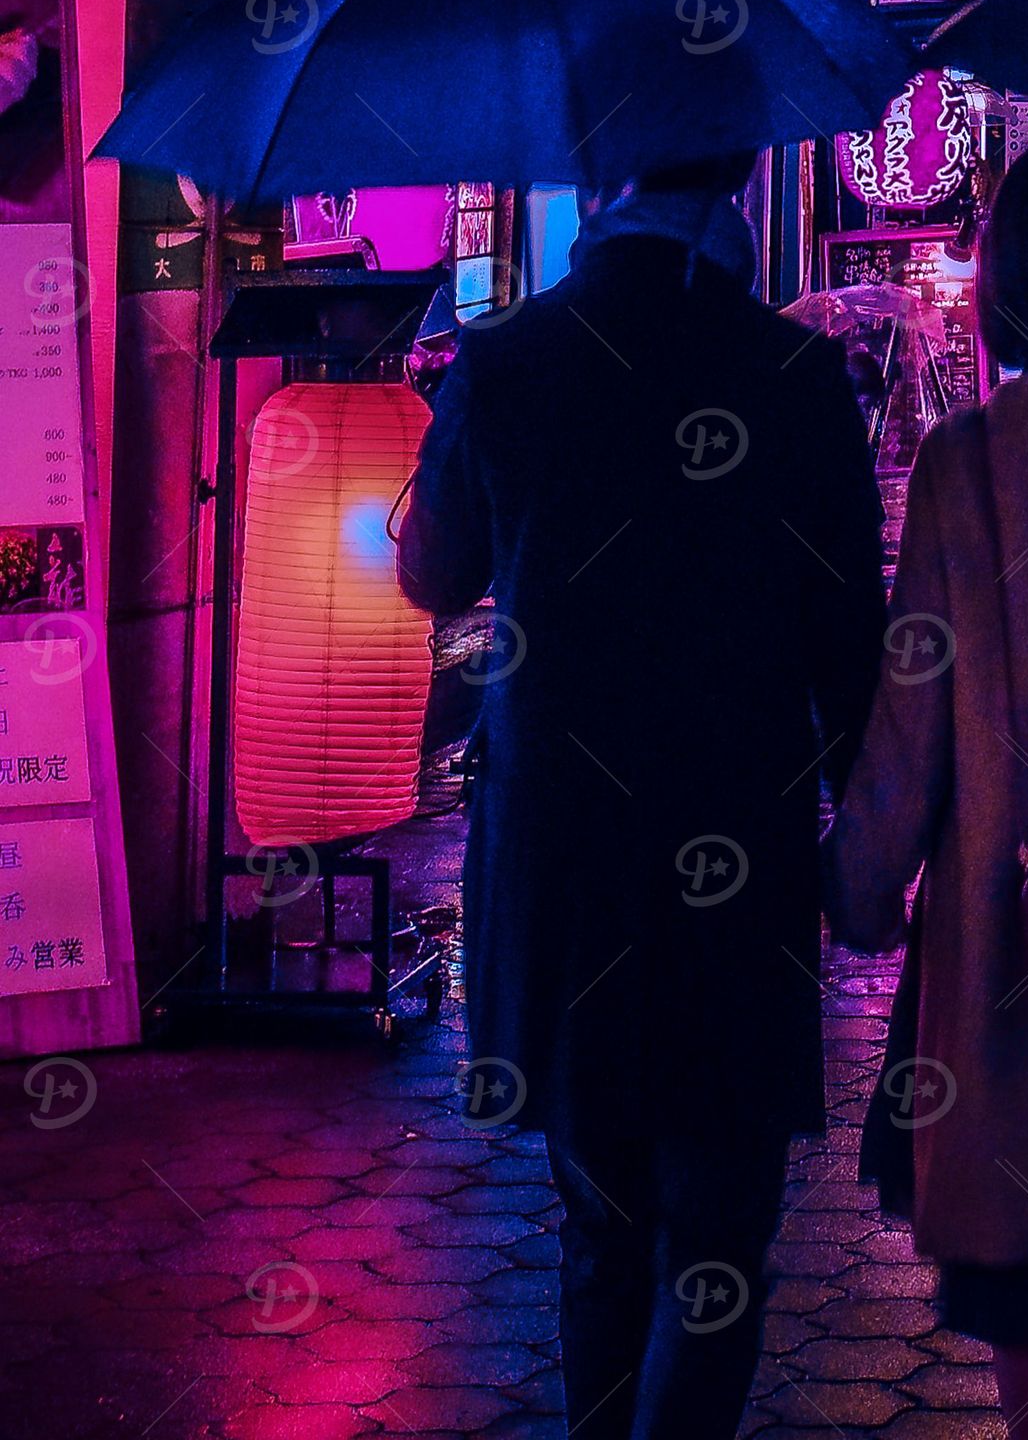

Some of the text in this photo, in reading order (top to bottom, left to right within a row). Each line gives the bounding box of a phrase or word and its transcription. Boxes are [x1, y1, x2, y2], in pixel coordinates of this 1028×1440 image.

[154, 257, 172, 279] 大
[5, 936, 85, 971] み営業
